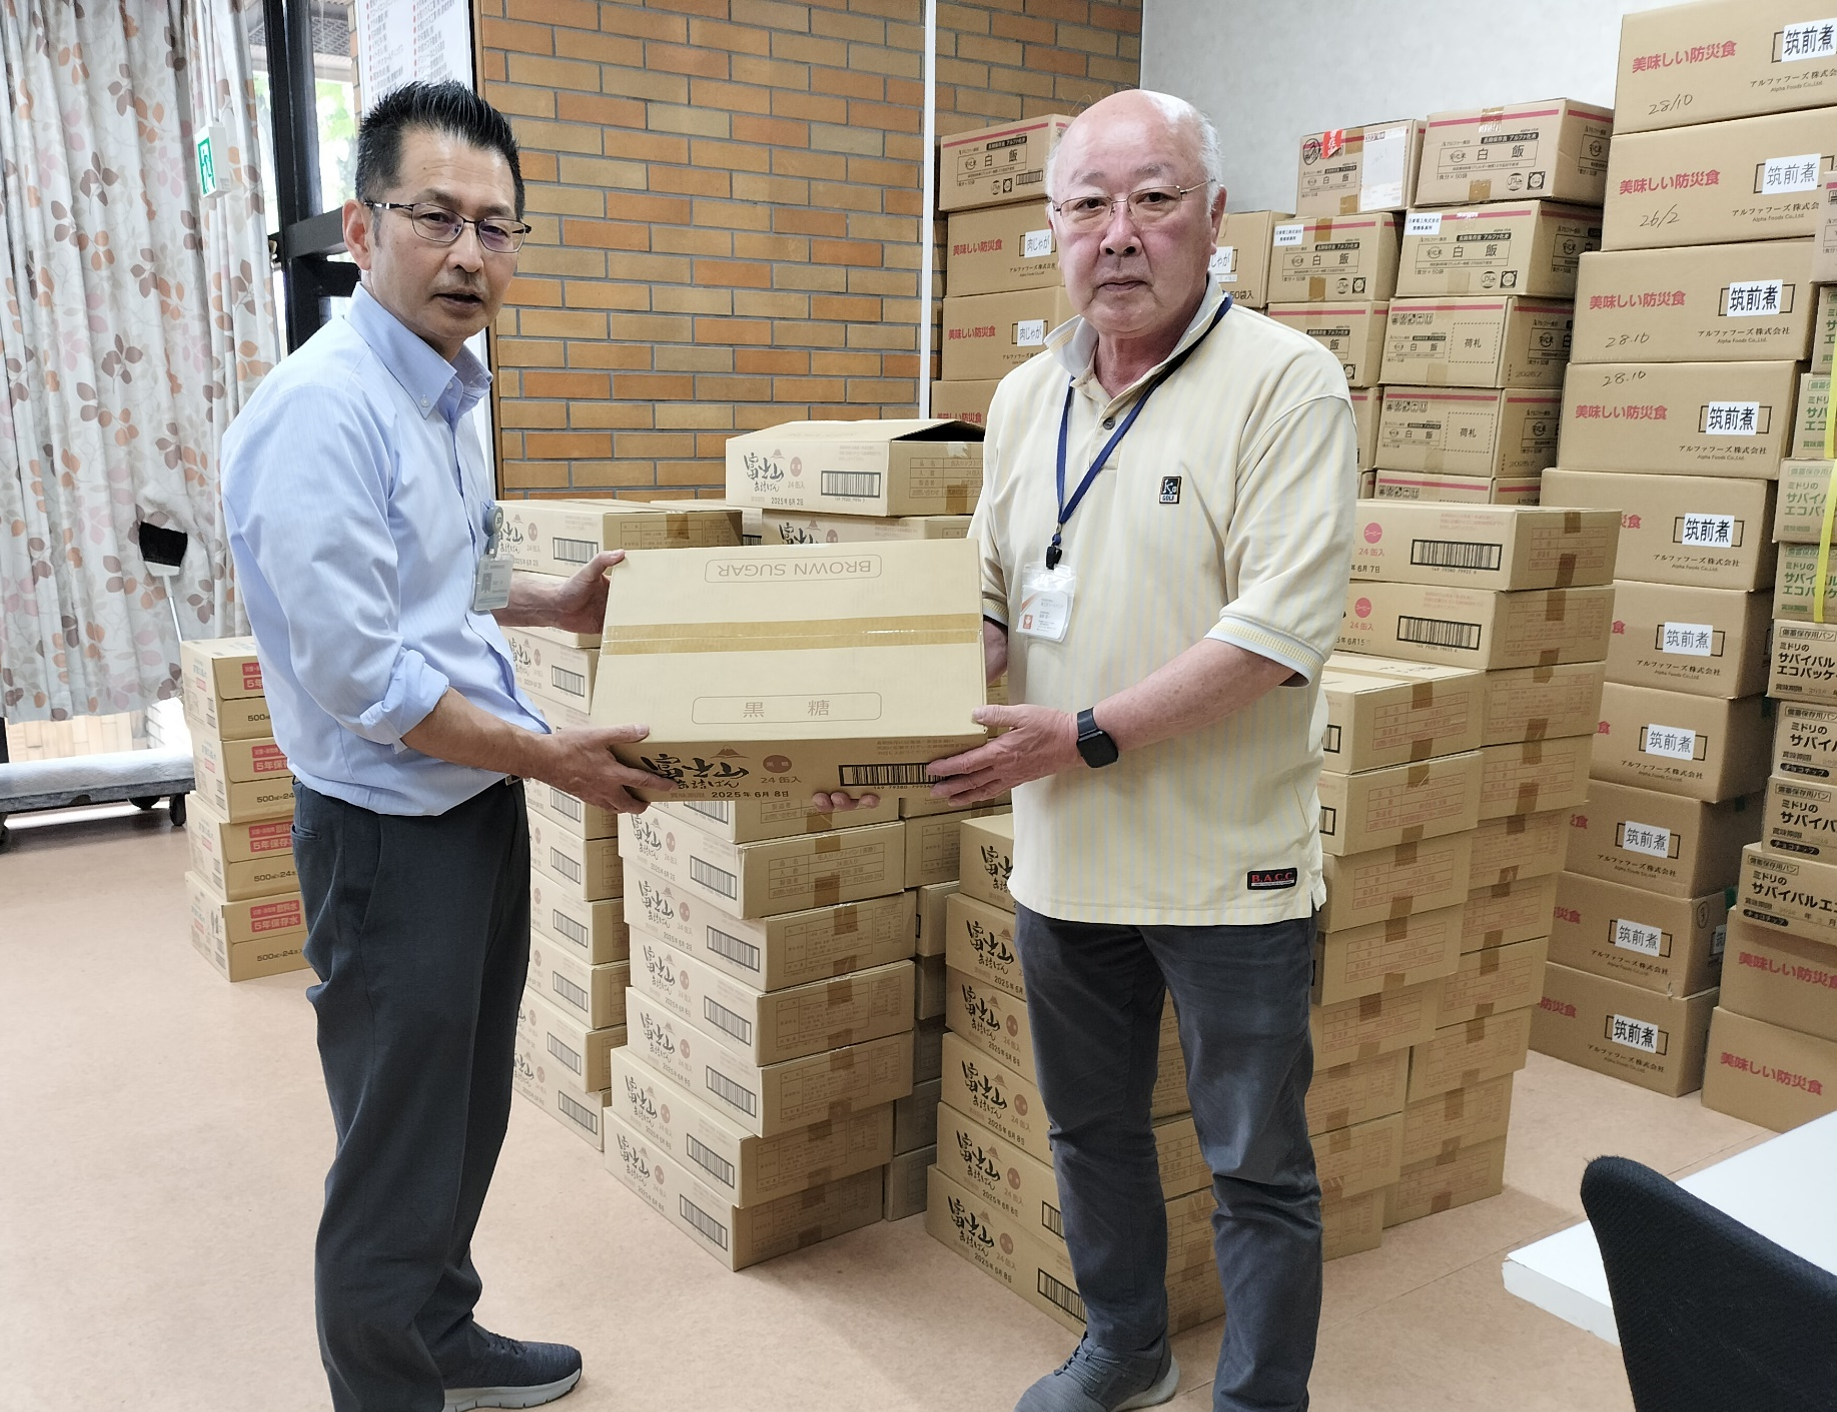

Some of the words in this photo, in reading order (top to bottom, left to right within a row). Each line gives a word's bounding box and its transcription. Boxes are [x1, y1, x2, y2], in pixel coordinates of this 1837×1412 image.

[1784, 24, 1834, 56] 筑前煮
[1632, 40, 1737, 73] 美味しい防災食
[1477, 144, 1524, 161] 白飯
[1619, 169, 1721, 195] 美味しい防災食
[1766, 162, 1816, 186] 筑前煮
[953, 239, 1002, 256] 美味しい防災食
[1027, 235, 1050, 252] 肉じゃが
[1453, 244, 1498, 258] 白飯
[1312, 253, 1349, 265] 白飯
[1590, 290, 1686, 310] 美味しい防災食
[1729, 285, 1778, 312] 筑前煮
[948, 325, 996, 340] 美味しい防災食
[1020, 327, 1042, 340] 肉じゃが
[1698, 327, 1790, 337] アルファフーズ株式会社
[1464, 338, 1481, 348] 荷札
[1808, 396, 1829, 404] ミドリ
[1575, 405, 1667, 420] 美味しい防災食
[1708, 405, 1755, 431] 筑前煮
[1460, 428, 1477, 438] 荷札
[1679, 445, 1767, 455] アルファフーズ株式会社
[744, 452, 785, 482] 富士山
[1788, 482, 1818, 490] ミドリの
[1785, 506, 1825, 516] エコバ
[1685, 517, 1731, 543] 筑前煮
[718, 563, 786, 577] SUGAR
[794, 560, 871, 576] BROWN
[1653, 554, 1740, 567] アルファフーズ株式会社
[1786, 562, 1814, 570] ミドリの
[1666, 629, 1709, 650] 筑前煮
[1783, 629, 1834, 640] 備蓄保存用パン
[1780, 642, 1809, 652] ミドリの
[1637, 659, 1721, 676] アルファフーズ株式会社
[1778, 652, 1835, 668] サバイバル
[1777, 665, 1837, 680] エコバッケ
[743, 700, 830, 718] 黒糖
[1791, 722, 1827, 734] ミドリの
[1649, 731, 1692, 754] 筑前煮
[640, 754, 749, 779] 富士山
[1621, 760, 1703, 780] アルファフーズ株式会社
[1782, 799, 1818, 813] ミドリの
[1626, 827, 1667, 852] 筑前煮
[1597, 854, 1676, 877] アルファフーズ株式会社
[1753, 870, 1786, 886] ミドリの
[638, 880, 674, 919] 富士山
[254, 915, 299, 930] 5年保存水
[1554, 906, 1581, 925] 災食
[966, 920, 1014, 965] 富士山
[1618, 924, 1658, 950] 筑前煮
[643, 944, 675, 986] 富士山
[1591, 949, 1669, 975] アルファフーズ株式会社
[962, 983, 1000, 1031] 富士山
[640, 1012, 675, 1054] 富士山
[1614, 1019, 1655, 1049] 筑前煮
[1588, 1044, 1664, 1072] アルファフーズ株式会社
[1720, 1051, 1823, 1096] 美味しい防災食
[961, 1060, 1007, 1110] 富士山
[625, 1074, 658, 1119] 富士山
[617, 1133, 650, 1178] 富士山
[956, 1130, 1000, 1181] 富士山
[948, 1196, 995, 1248] 富士山
